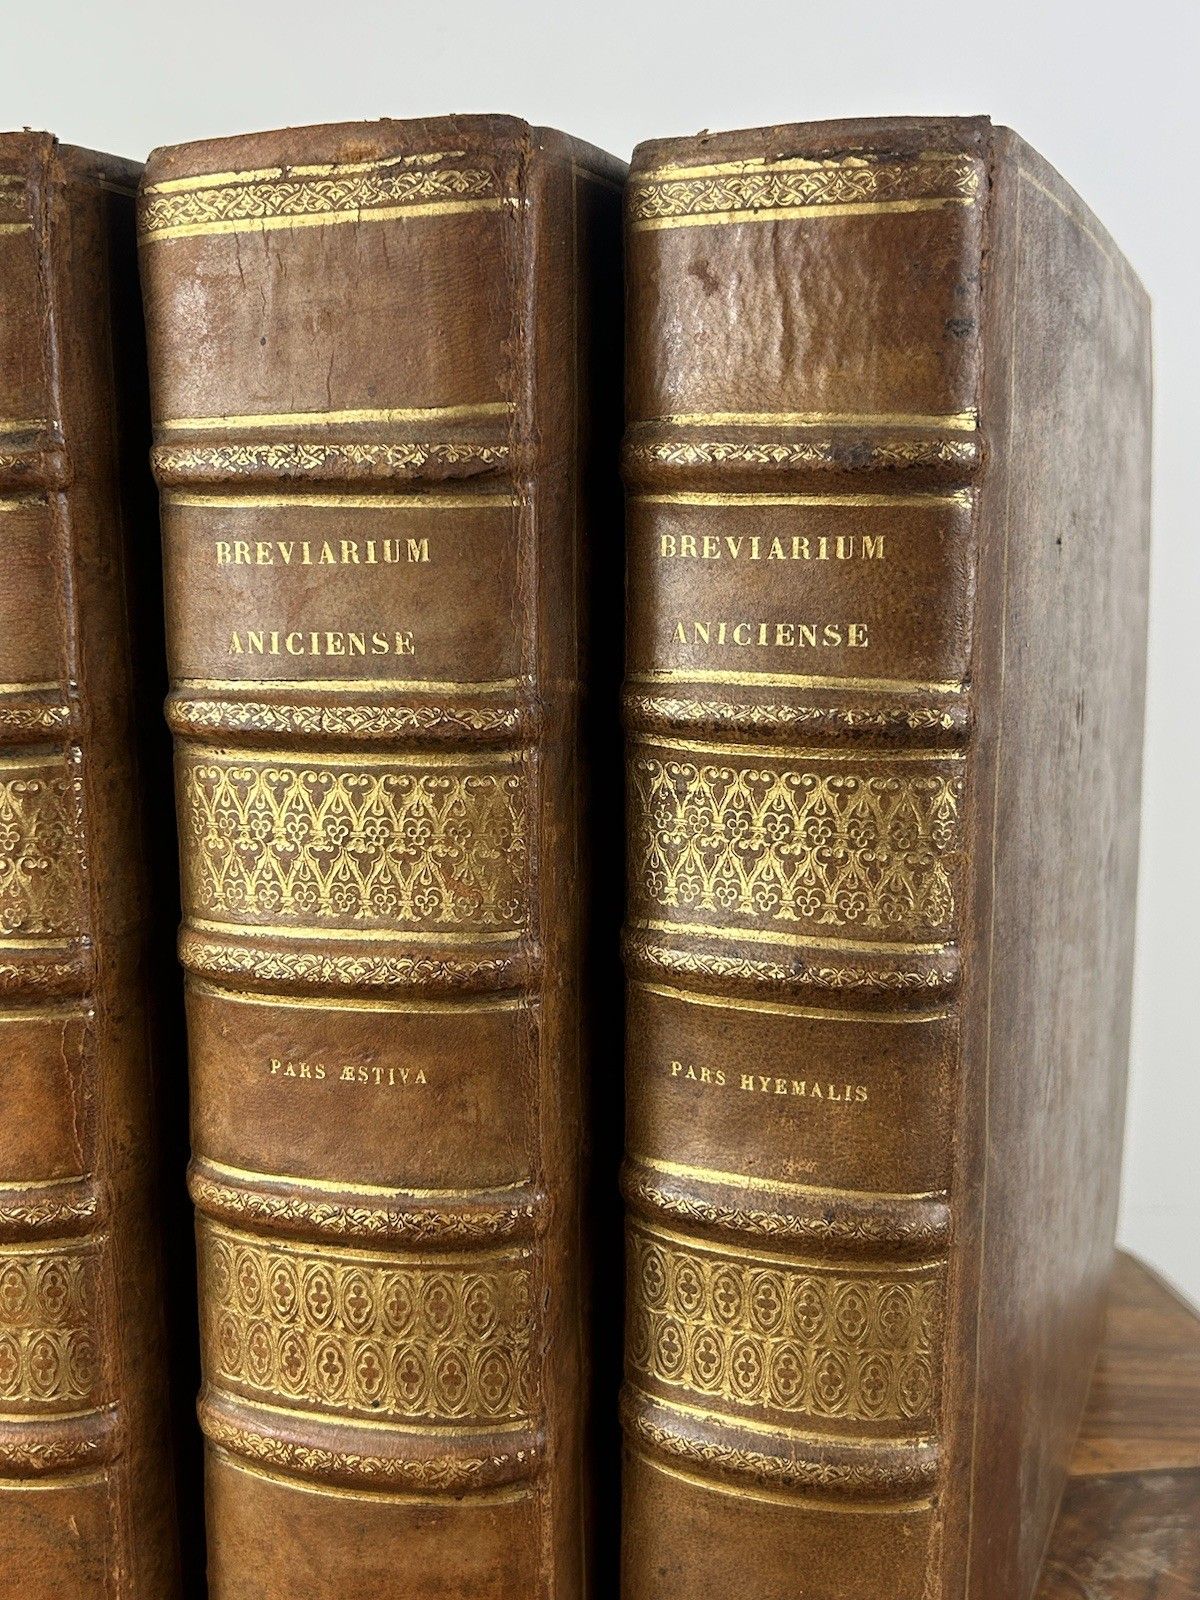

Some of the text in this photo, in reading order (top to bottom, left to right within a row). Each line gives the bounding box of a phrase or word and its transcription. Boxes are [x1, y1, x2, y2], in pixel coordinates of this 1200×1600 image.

[215, 538, 431, 566] BREVIARIUM
[660, 533, 886, 561] BREVIARIUM
[228, 630, 415, 656] ANICIENSE
[671, 621, 869, 648] ANICIENSE
[270, 1058, 427, 1086] PARS ÆSTIVA
[670, 1060, 868, 1102] PARS HYEMALIS
